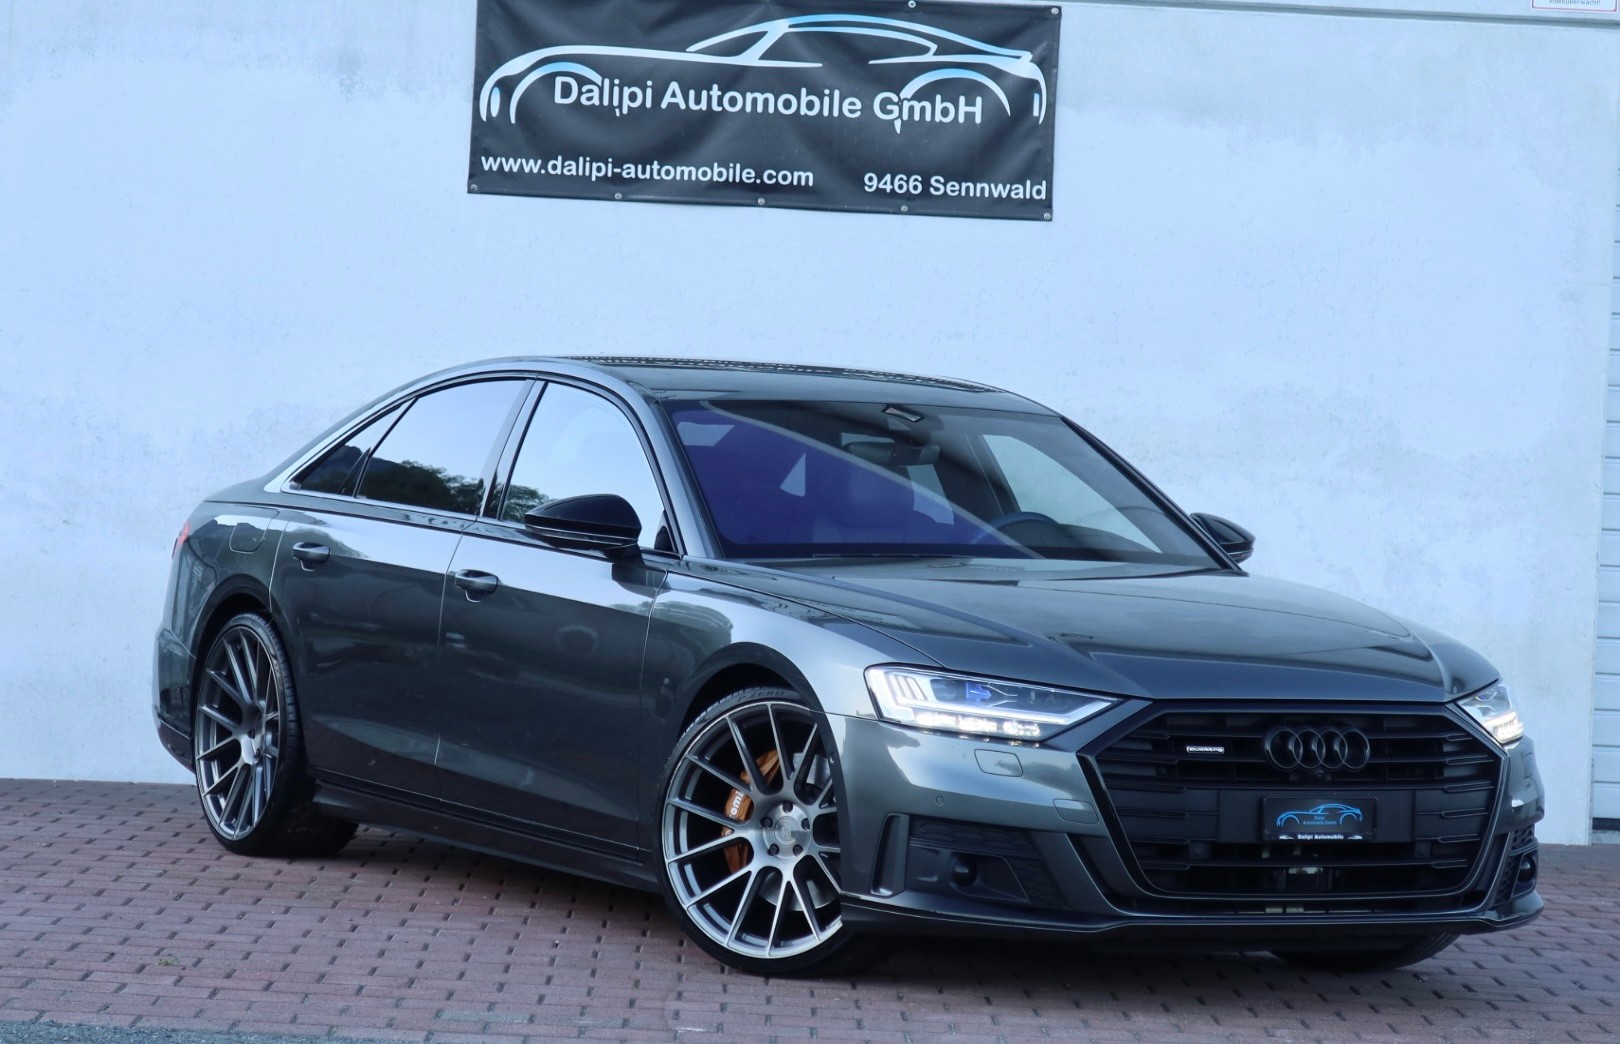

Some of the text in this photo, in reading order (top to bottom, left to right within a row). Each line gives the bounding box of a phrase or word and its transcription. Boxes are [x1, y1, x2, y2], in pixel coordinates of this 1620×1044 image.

[554, 76, 982, 124] Dalipi Automobile GmbH
[481, 155, 814, 186] www.dalipi-automobile.com
[863, 172, 1046, 200] 9466 Sennwald
